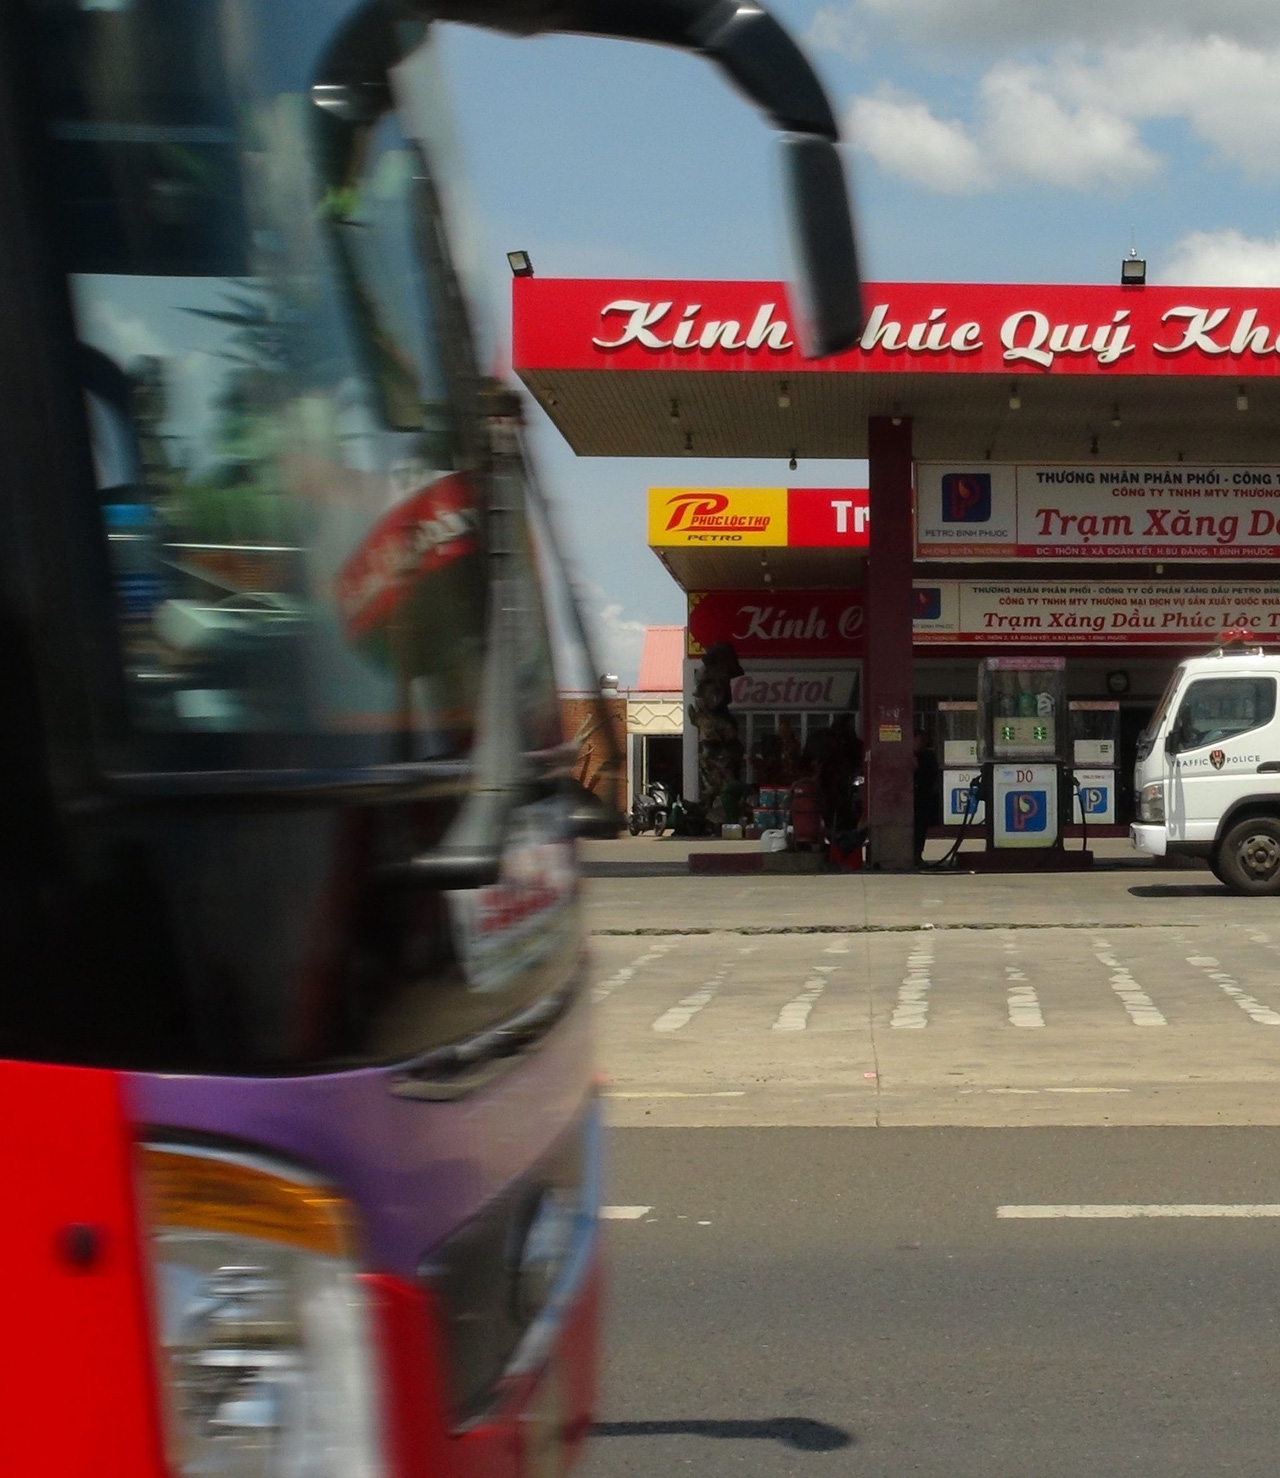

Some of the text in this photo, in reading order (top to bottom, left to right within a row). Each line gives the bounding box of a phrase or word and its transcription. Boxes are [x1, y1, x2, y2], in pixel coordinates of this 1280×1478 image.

[592, 301, 793, 351] Kính
[856, 303, 983, 352] húc
[1000, 309, 1136, 368] Quý
[1036, 470, 1095, 484] THƯƠNG
[1099, 471, 1140, 484] NHÂN
[1144, 471, 1183, 485] PHÂN
[1186, 469, 1220, 485] PHỐI
[1232, 471, 1272, 485] CÔNG
[1112, 487, 1146, 498] CÔNG
[1150, 489, 1164, 497] TY
[1169, 489, 1201, 498] TNHH
[1204, 489, 1230, 498] MTV
[831, 500, 870, 533] Tr
[1035, 508, 1134, 543] Trạm
[1142, 509, 1239, 544] Xăng
[1231, 587, 1262, 595] PETRO
[998, 597, 1023, 606] CÔNG
[1027, 598, 1039, 606] TY
[1042, 598, 1066, 606] TNHH
[1069, 598, 1089, 606] MTV
[732, 605, 864, 640] Kính C
[983, 612, 1042, 630] Trạm
[1047, 612, 1106, 631] Xăng
[1111, 608, 1156, 628] Dầu
[1160, 611, 1216, 628] Phúc
[732, 676, 834, 704] Castrol
[1171, 755, 1261, 768] TRAFFIC POLICE
[1016, 770, 1034, 782] DO
